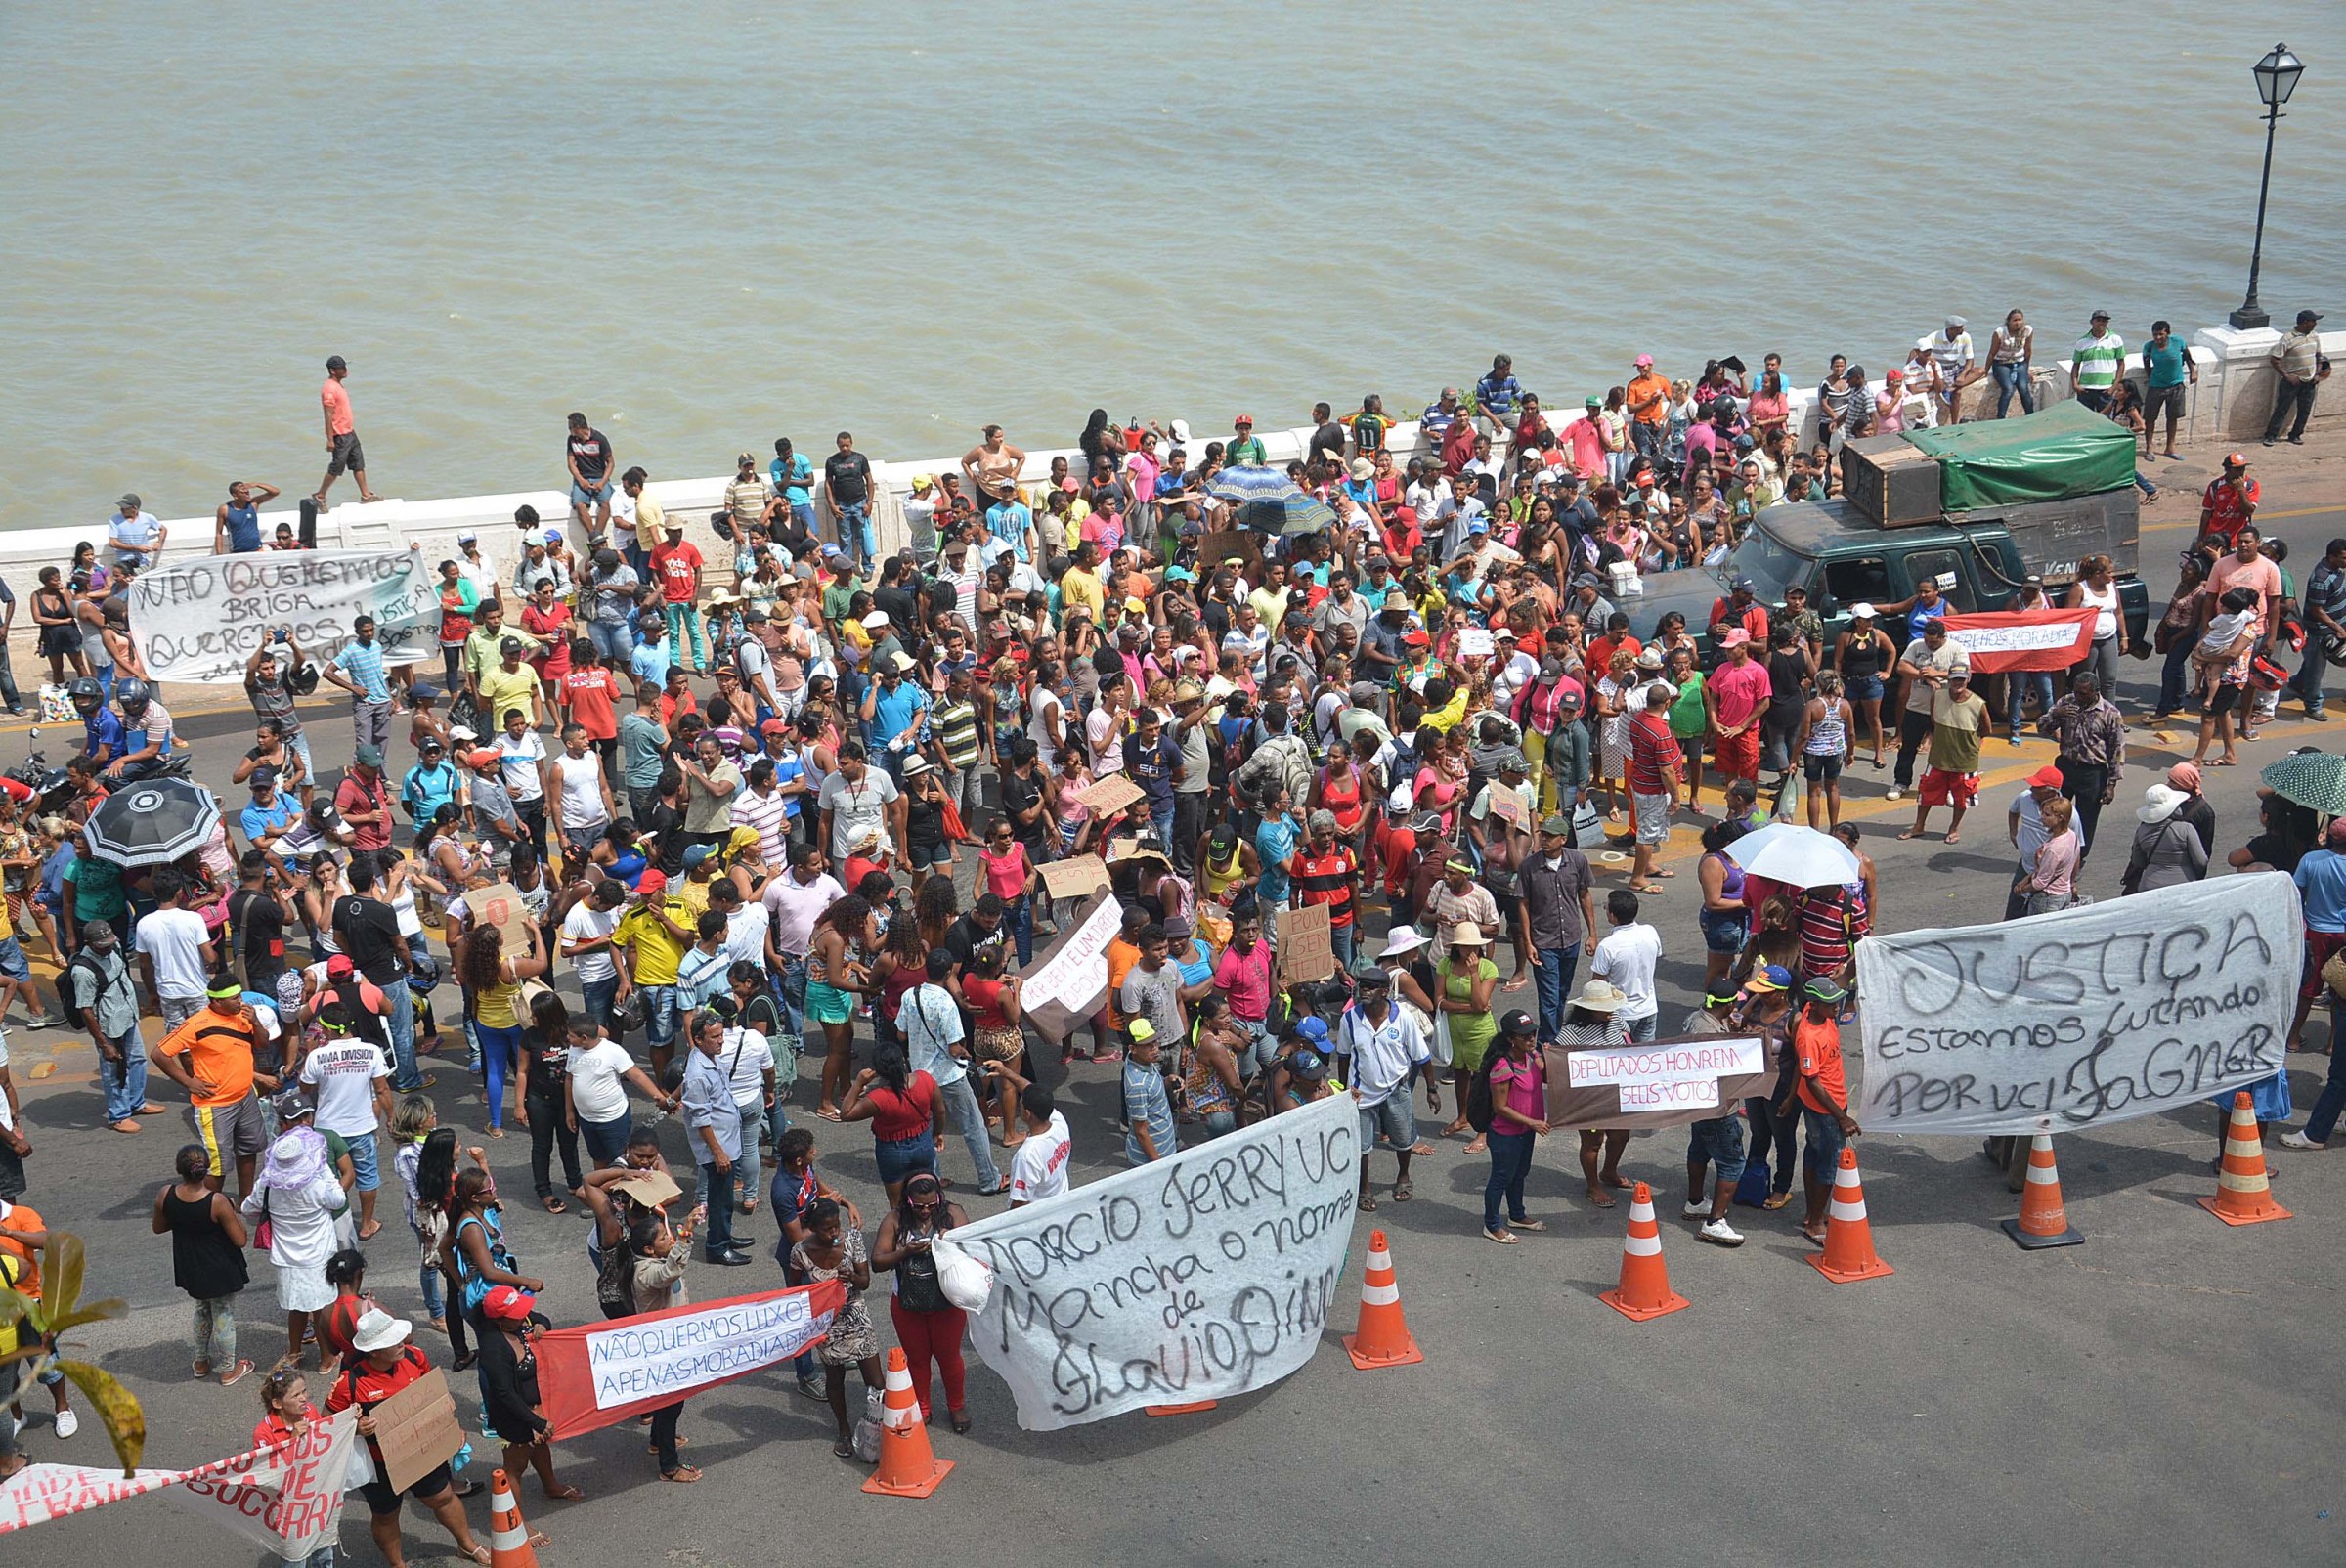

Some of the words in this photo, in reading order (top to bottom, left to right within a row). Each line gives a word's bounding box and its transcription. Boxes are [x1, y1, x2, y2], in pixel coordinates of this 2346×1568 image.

[1360, 428, 1375, 447] 11
[140, 568, 213, 611] NÃO
[222, 555, 413, 594] QUEREMOS
[1074, 932, 1094, 957] UM
[1295, 930, 1330, 955] SEM
[1289, 954, 1330, 980] TETO
[1889, 911, 2272, 1015] JUSTIÇA
[341, 1048, 374, 1061] DIVISION
[1571, 1054, 1661, 1080] DEPUTADOS
[1666, 1047, 1742, 1071] HONREM
[1622, 1083, 1660, 1105] SEUS
[1662, 1079, 1718, 1103] VOTOS
[1873, 1072, 1980, 1117] POR
[1162, 1287, 1205, 1330] de
[592, 1329, 642, 1365] NÃO
[641, 1313, 742, 1359] QUERMOS
[745, 1301, 803, 1333] LUXO
[599, 1363, 692, 1401] APENAS
[693, 1335, 786, 1376] MORADIA
